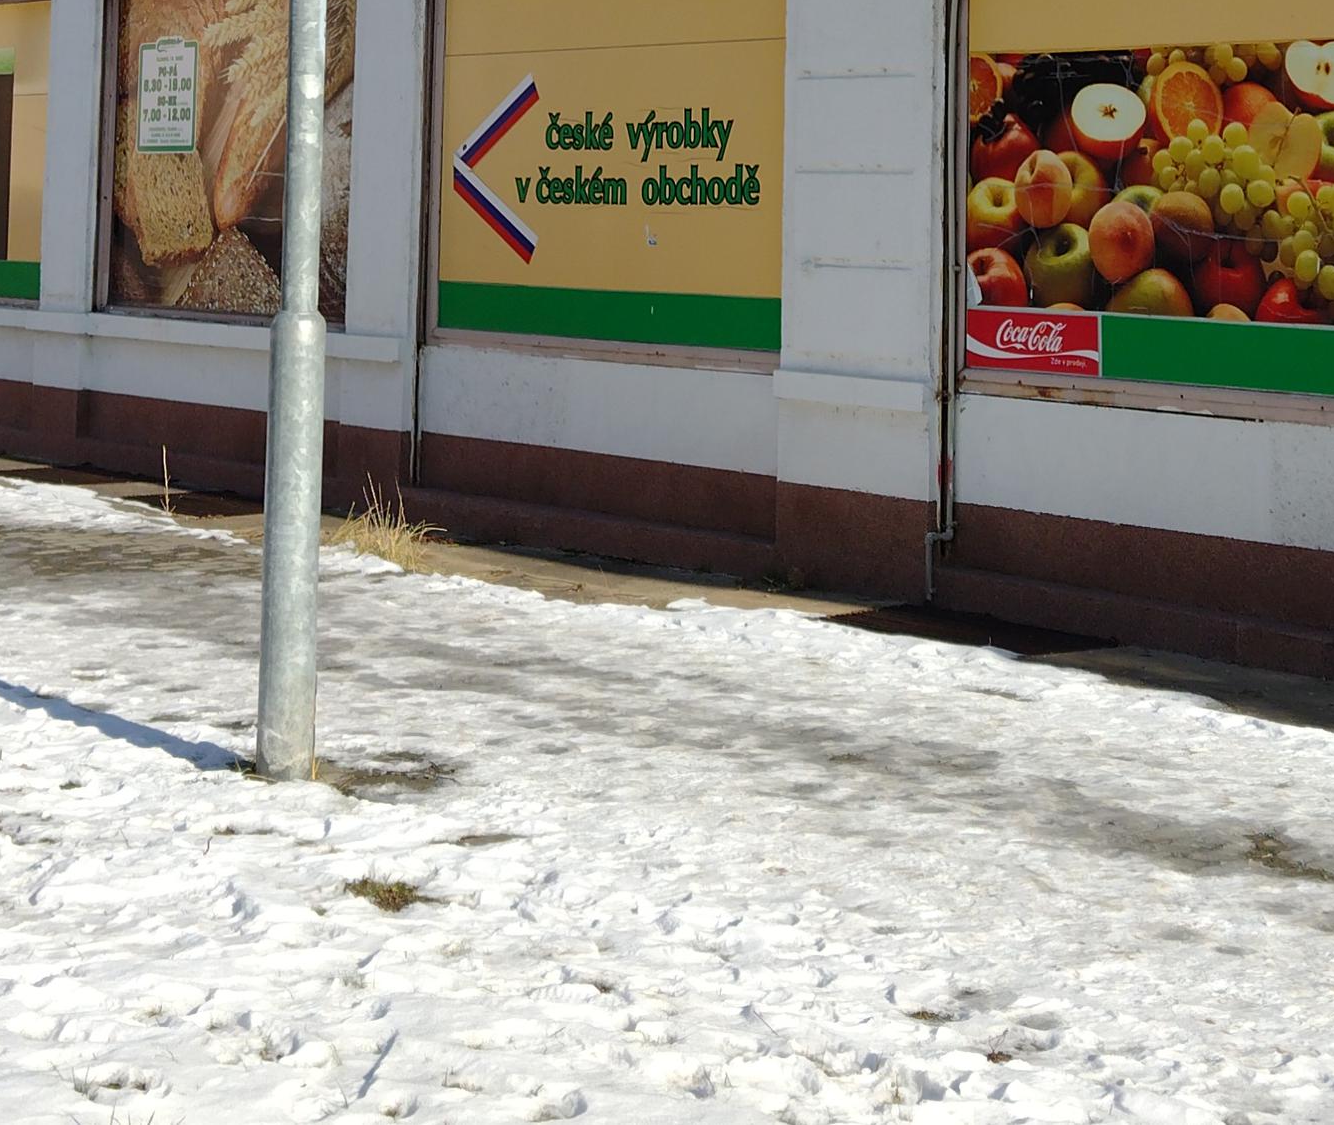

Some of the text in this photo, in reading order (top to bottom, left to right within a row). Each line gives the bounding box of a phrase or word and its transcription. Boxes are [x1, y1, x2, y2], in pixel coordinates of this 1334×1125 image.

[544, 107, 734, 163] české výrobky
[515, 164, 760, 207] v českém obchodě
[995, 318, 1067, 352] Coca-Cola
